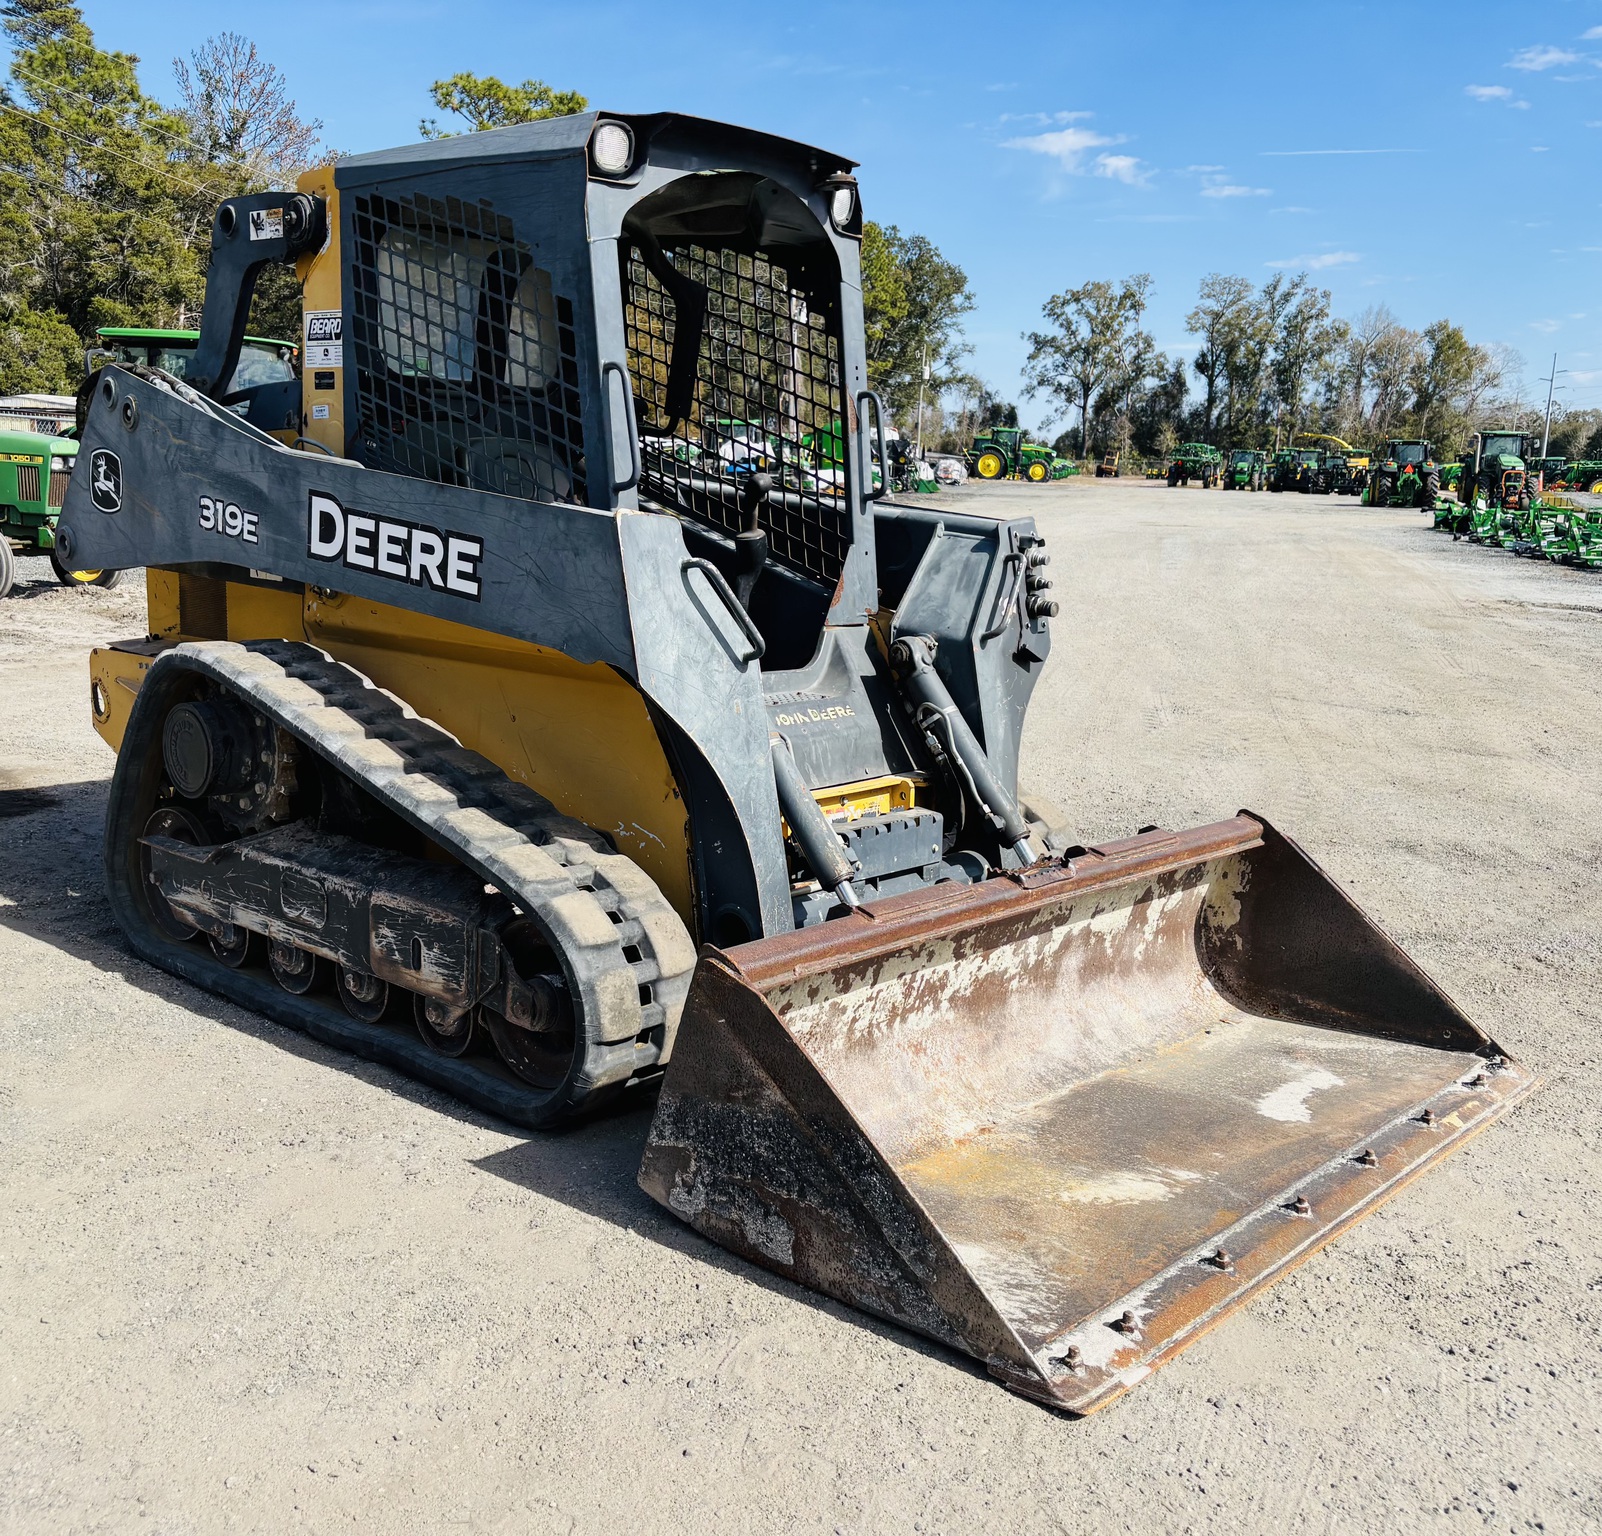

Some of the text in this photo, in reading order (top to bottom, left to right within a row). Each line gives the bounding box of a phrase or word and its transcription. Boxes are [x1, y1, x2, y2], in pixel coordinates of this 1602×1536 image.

[310, 318, 342, 340] BEARD
[10, 454, 30, 462] 1050
[199, 496, 259, 543] 319E
[310, 494, 482, 597] DEERE
[807, 705, 855, 722] DEERE
